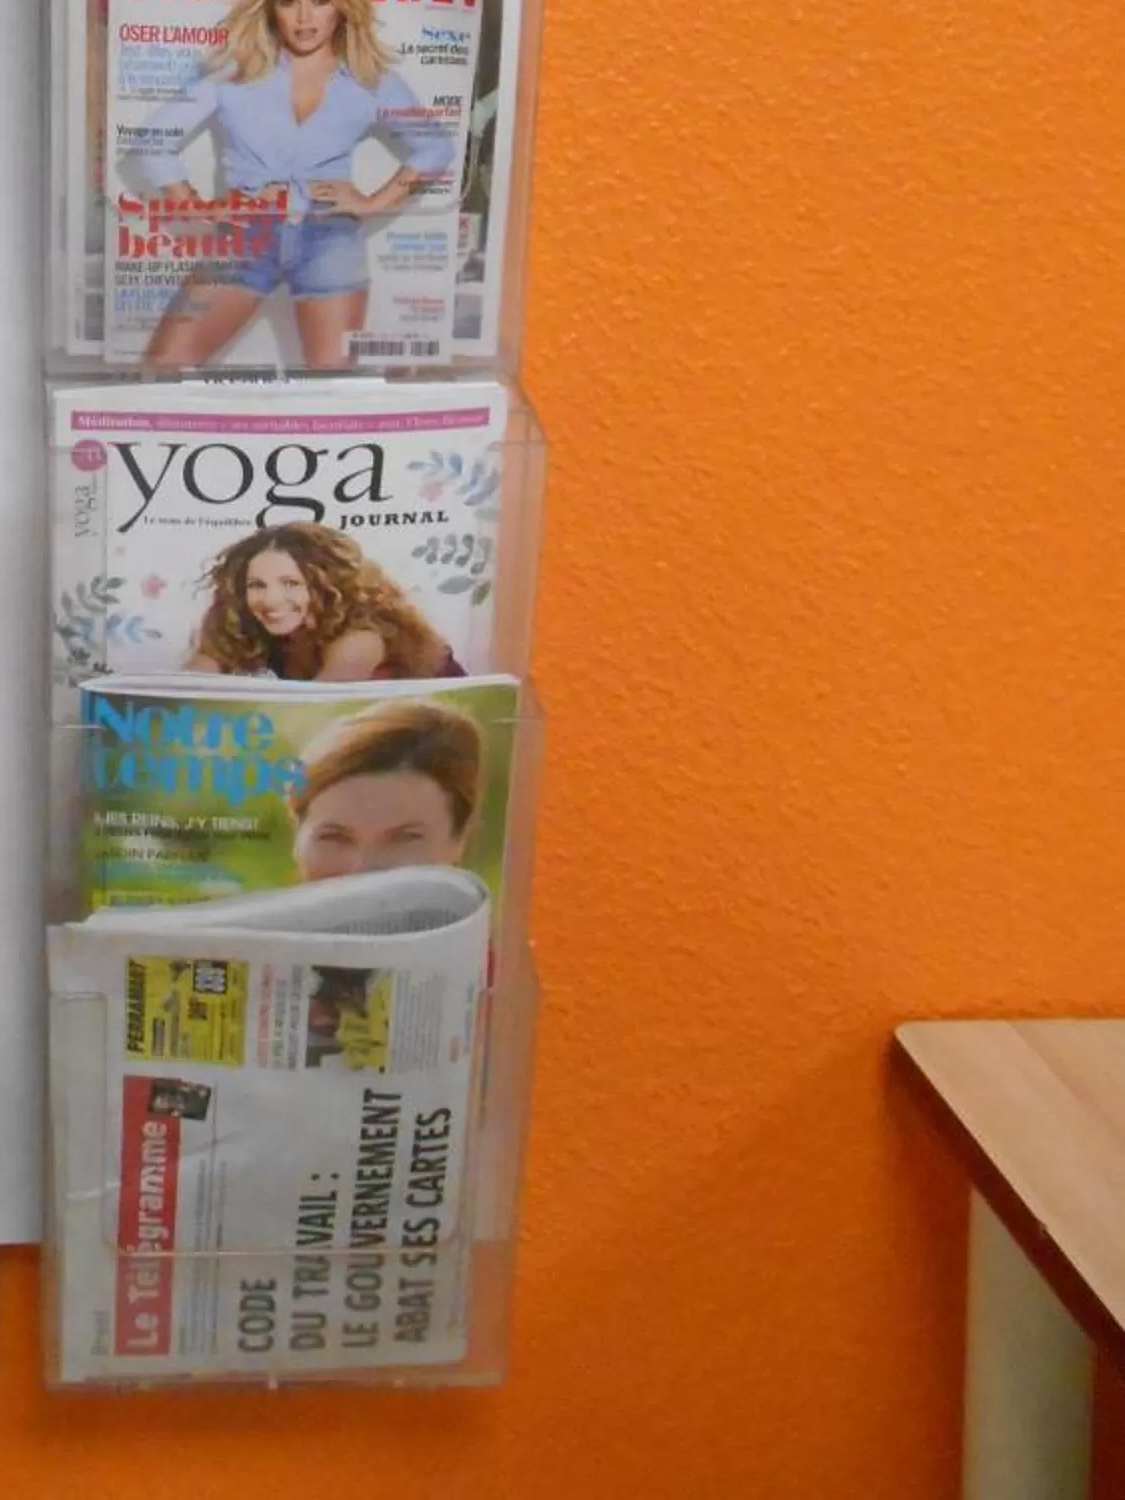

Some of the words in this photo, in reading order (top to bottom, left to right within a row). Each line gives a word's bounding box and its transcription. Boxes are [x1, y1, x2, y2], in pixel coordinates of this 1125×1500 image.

[119, 24, 160, 42] OSER
[107, 441, 393, 534] yoga
[339, 510, 449, 530] JOURNAL
[94, 694, 273, 751] Notre
[406, 1106, 452, 1209] CARTES
[126, 1120, 169, 1304] Télégramme
[344, 1086, 403, 1312] GOUVERNEMENT
[292, 1188, 339, 1300] TRAVAIL
[399, 1217, 441, 1266] SES
[126, 1315, 160, 1348] Le
[237, 1277, 277, 1354] CODE
[290, 1312, 328, 1352] DU
[343, 1322, 381, 1349] LE
[394, 1275, 433, 1345] ABAT
